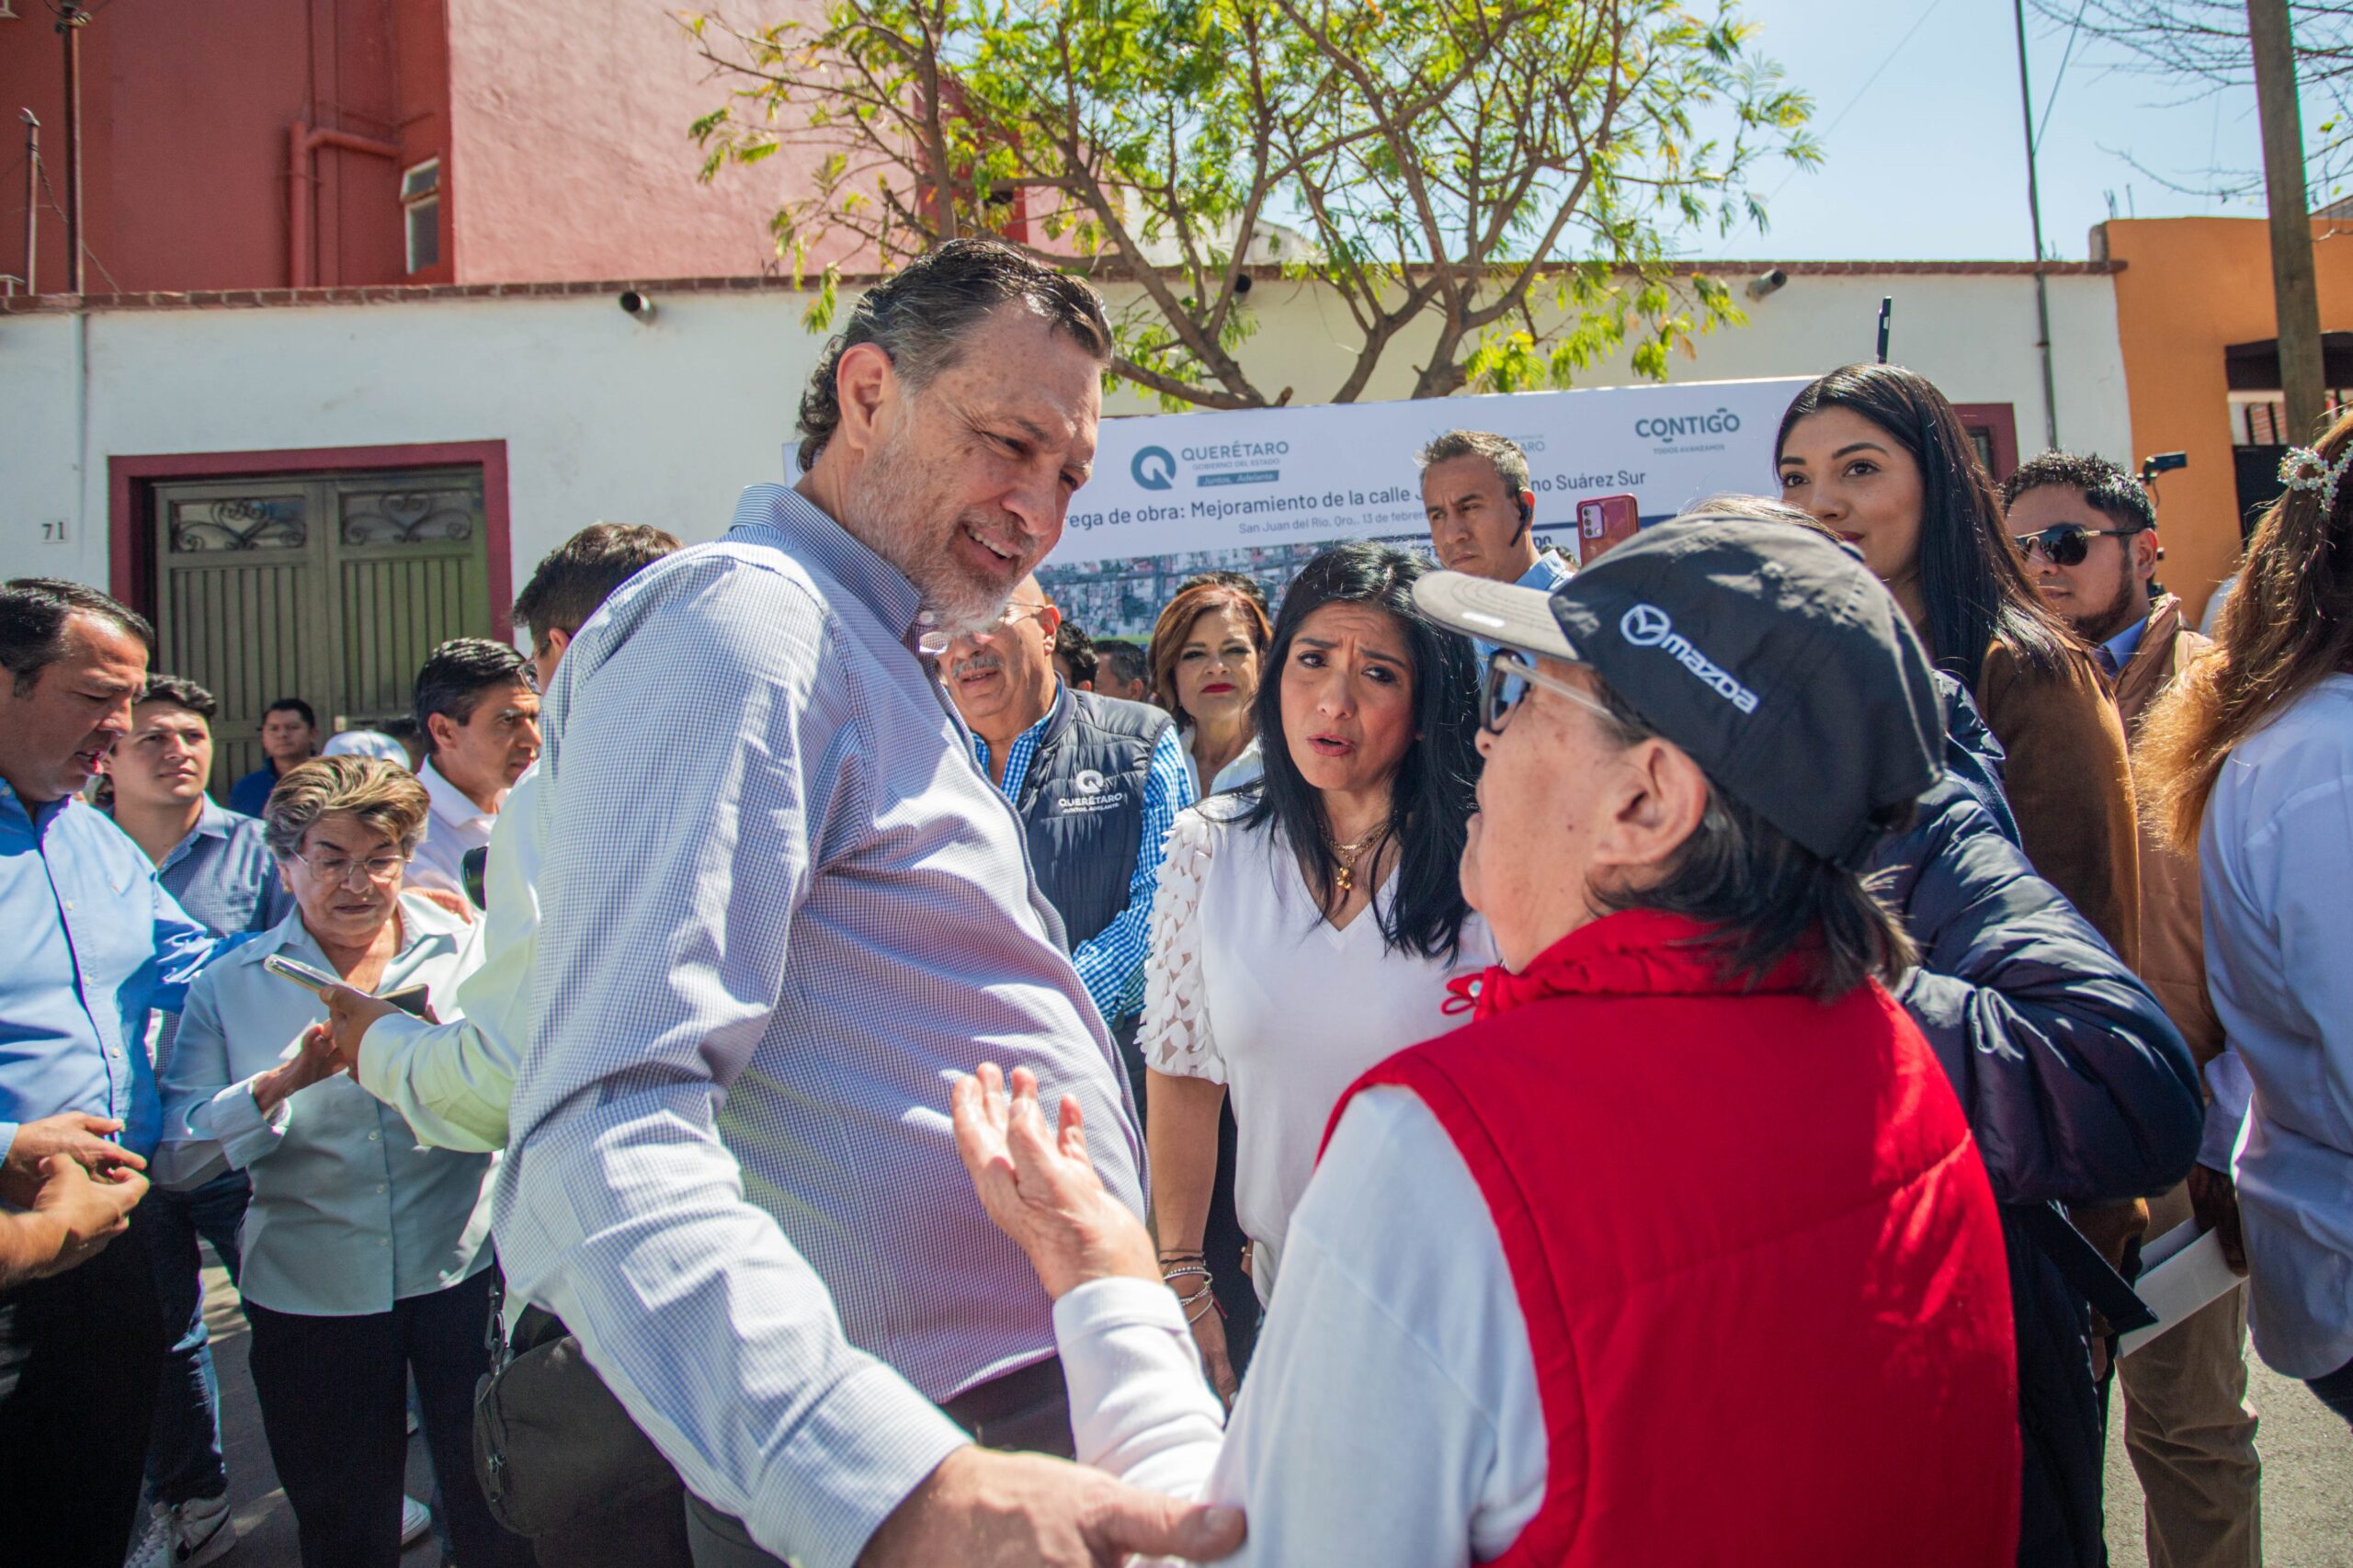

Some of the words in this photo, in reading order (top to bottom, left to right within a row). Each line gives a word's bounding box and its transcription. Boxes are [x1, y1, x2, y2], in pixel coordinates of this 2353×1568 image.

[1635, 409, 1740, 441] CONTIGO
[1181, 440, 1289, 460] QUERÉTARO
[1192, 460, 1233, 471] GOBIERNO
[1251, 458, 1280, 467] ESTADO
[1108, 507, 1131, 525] de
[1136, 506, 1185, 522] obra:
[1191, 495, 1317, 520] Mejoramiento
[1323, 491, 1344, 507] de
[1348, 490, 1364, 505] la
[1369, 486, 1411, 505] calle
[1556, 472, 1614, 490] Suárez
[1618, 470, 1646, 486] Sur
[41, 521, 64, 540] 71
[1238, 522, 1260, 534] San
[1262, 520, 1290, 532] Juan
[1292, 517, 1310, 530] del
[1362, 514, 1372, 525] 13
[1375, 512, 1389, 523] de
[1660, 632, 1759, 714] mazda
[1058, 792, 1122, 806] QUERÉTARO
